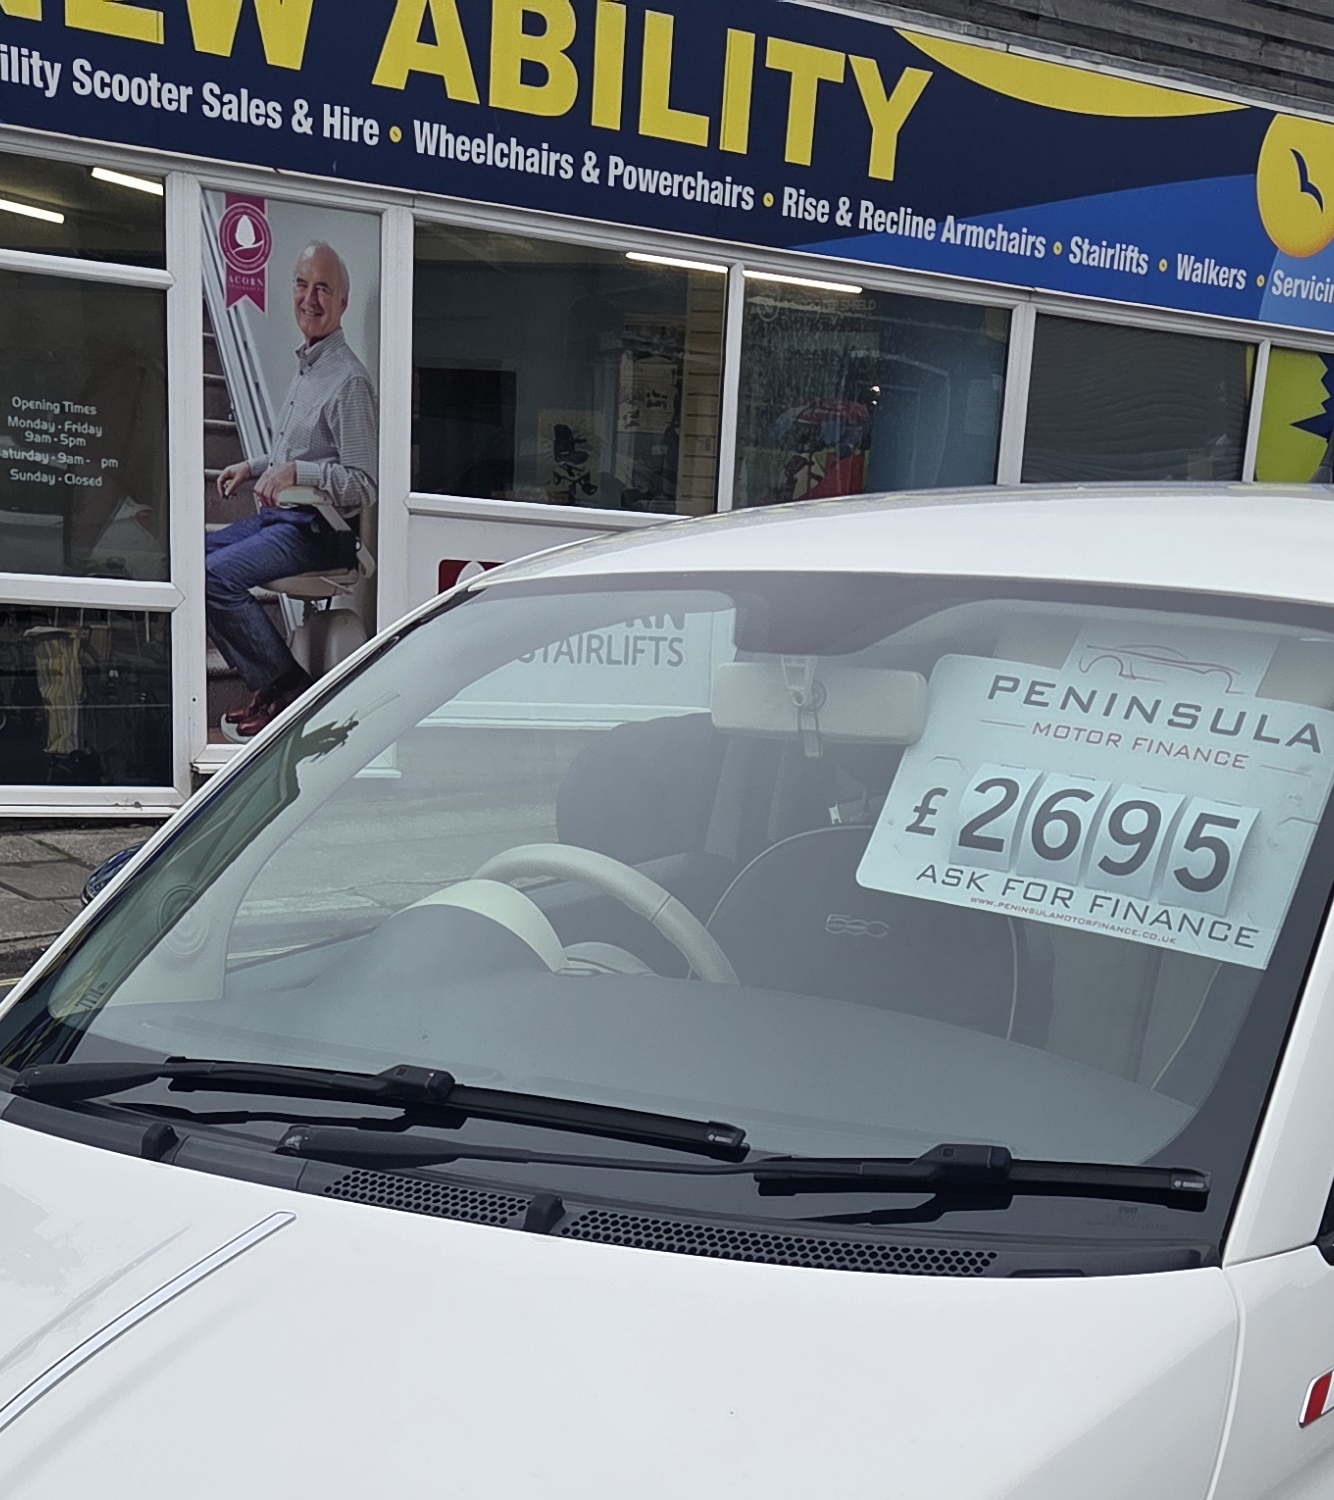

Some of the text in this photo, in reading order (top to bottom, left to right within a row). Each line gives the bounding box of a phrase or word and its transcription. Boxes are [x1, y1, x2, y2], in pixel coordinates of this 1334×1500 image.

[371, 0, 934, 182] ABILITY
[72, 58, 193, 113] Scooter
[201, 81, 283, 130] Sales
[291, 98, 313, 135] &
[323, 102, 380, 146] Hire
[413, 118, 574, 180] Wheelchairs
[580, 150, 600, 184] &
[608, 154, 755, 211] Powerchairs
[782, 186, 830, 225] Rise
[835, 195, 852, 227] &
[859, 200, 936, 241] Recline
[940, 215, 1047, 259] Armchairs
[1068, 235, 1149, 275] Stairlifts
[1176, 252, 1247, 291] Walkers
[228, 274, 264, 287] ACORN
[11, 396, 97, 415] Opening Times
[7, 415, 56, 433] Monday
[64, 421, 103, 438] Friday
[25, 430, 52, 443] 9am
[59, 433, 86, 448] 5pm
[57, 452, 85, 465] 9am
[100, 457, 119, 469] pm
[9, 468, 56, 486] Sunday
[64, 473, 103, 487] Closed
[987, 673, 1323, 754] PENINSULA
[1031, 721, 1250, 770] MOTOR FINANCE
[915, 863, 1261, 949] ASK FOR FINANCE
